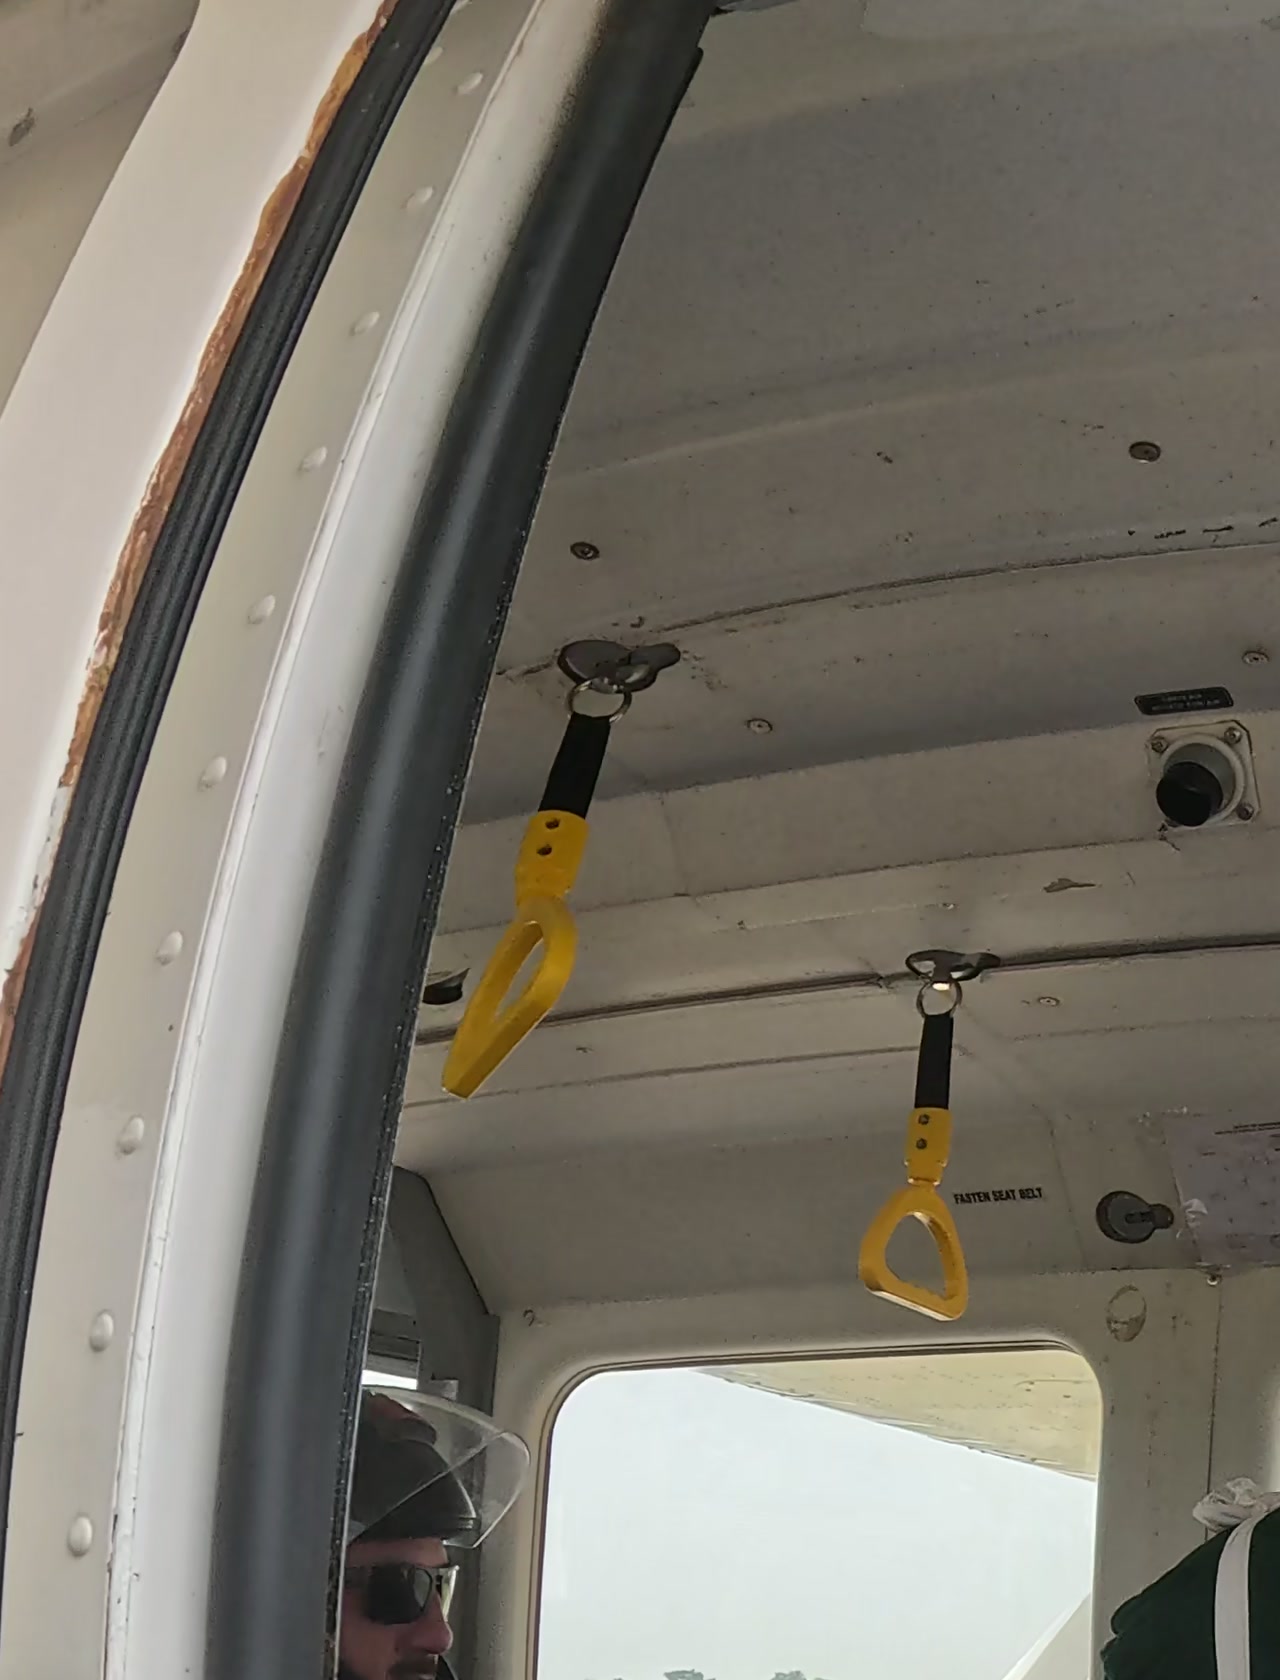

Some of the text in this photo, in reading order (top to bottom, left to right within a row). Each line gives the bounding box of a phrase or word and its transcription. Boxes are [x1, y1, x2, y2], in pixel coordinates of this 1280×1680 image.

[953, 1186, 1043, 1205] FASTEN SEAT BELT
